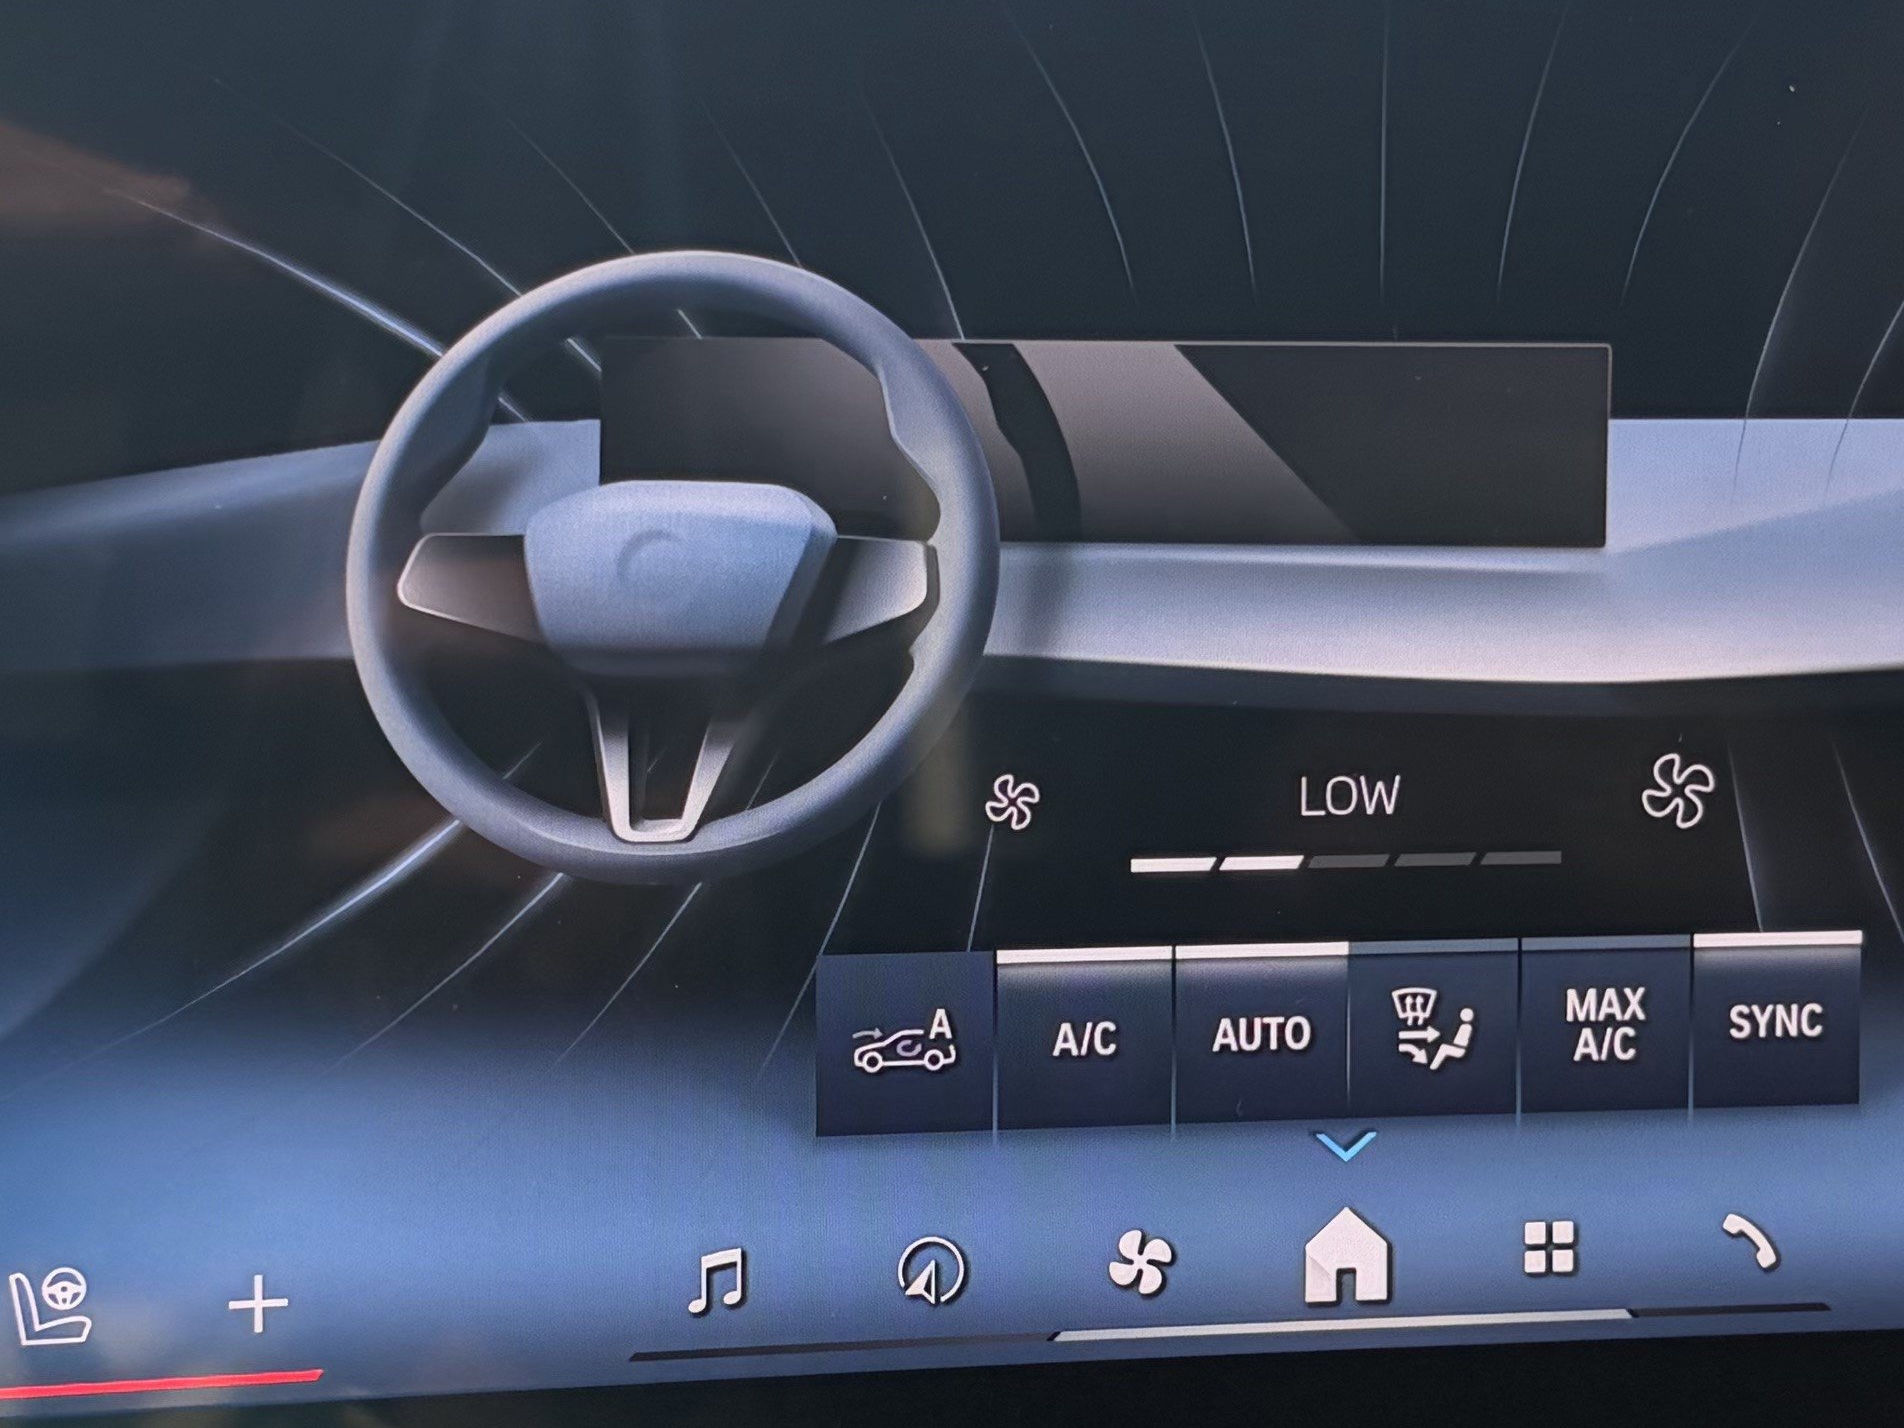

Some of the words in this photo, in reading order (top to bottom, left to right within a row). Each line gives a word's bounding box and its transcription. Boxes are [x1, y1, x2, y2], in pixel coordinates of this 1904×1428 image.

[1299, 773, 1402, 818] LOW
[1565, 984, 1648, 1023] MAX
[1728, 1001, 1824, 1040] SYNC
[1051, 1019, 1118, 1058] A/C
[1211, 1014, 1312, 1053] AUTO
[1571, 1023, 1639, 1064] A/C
